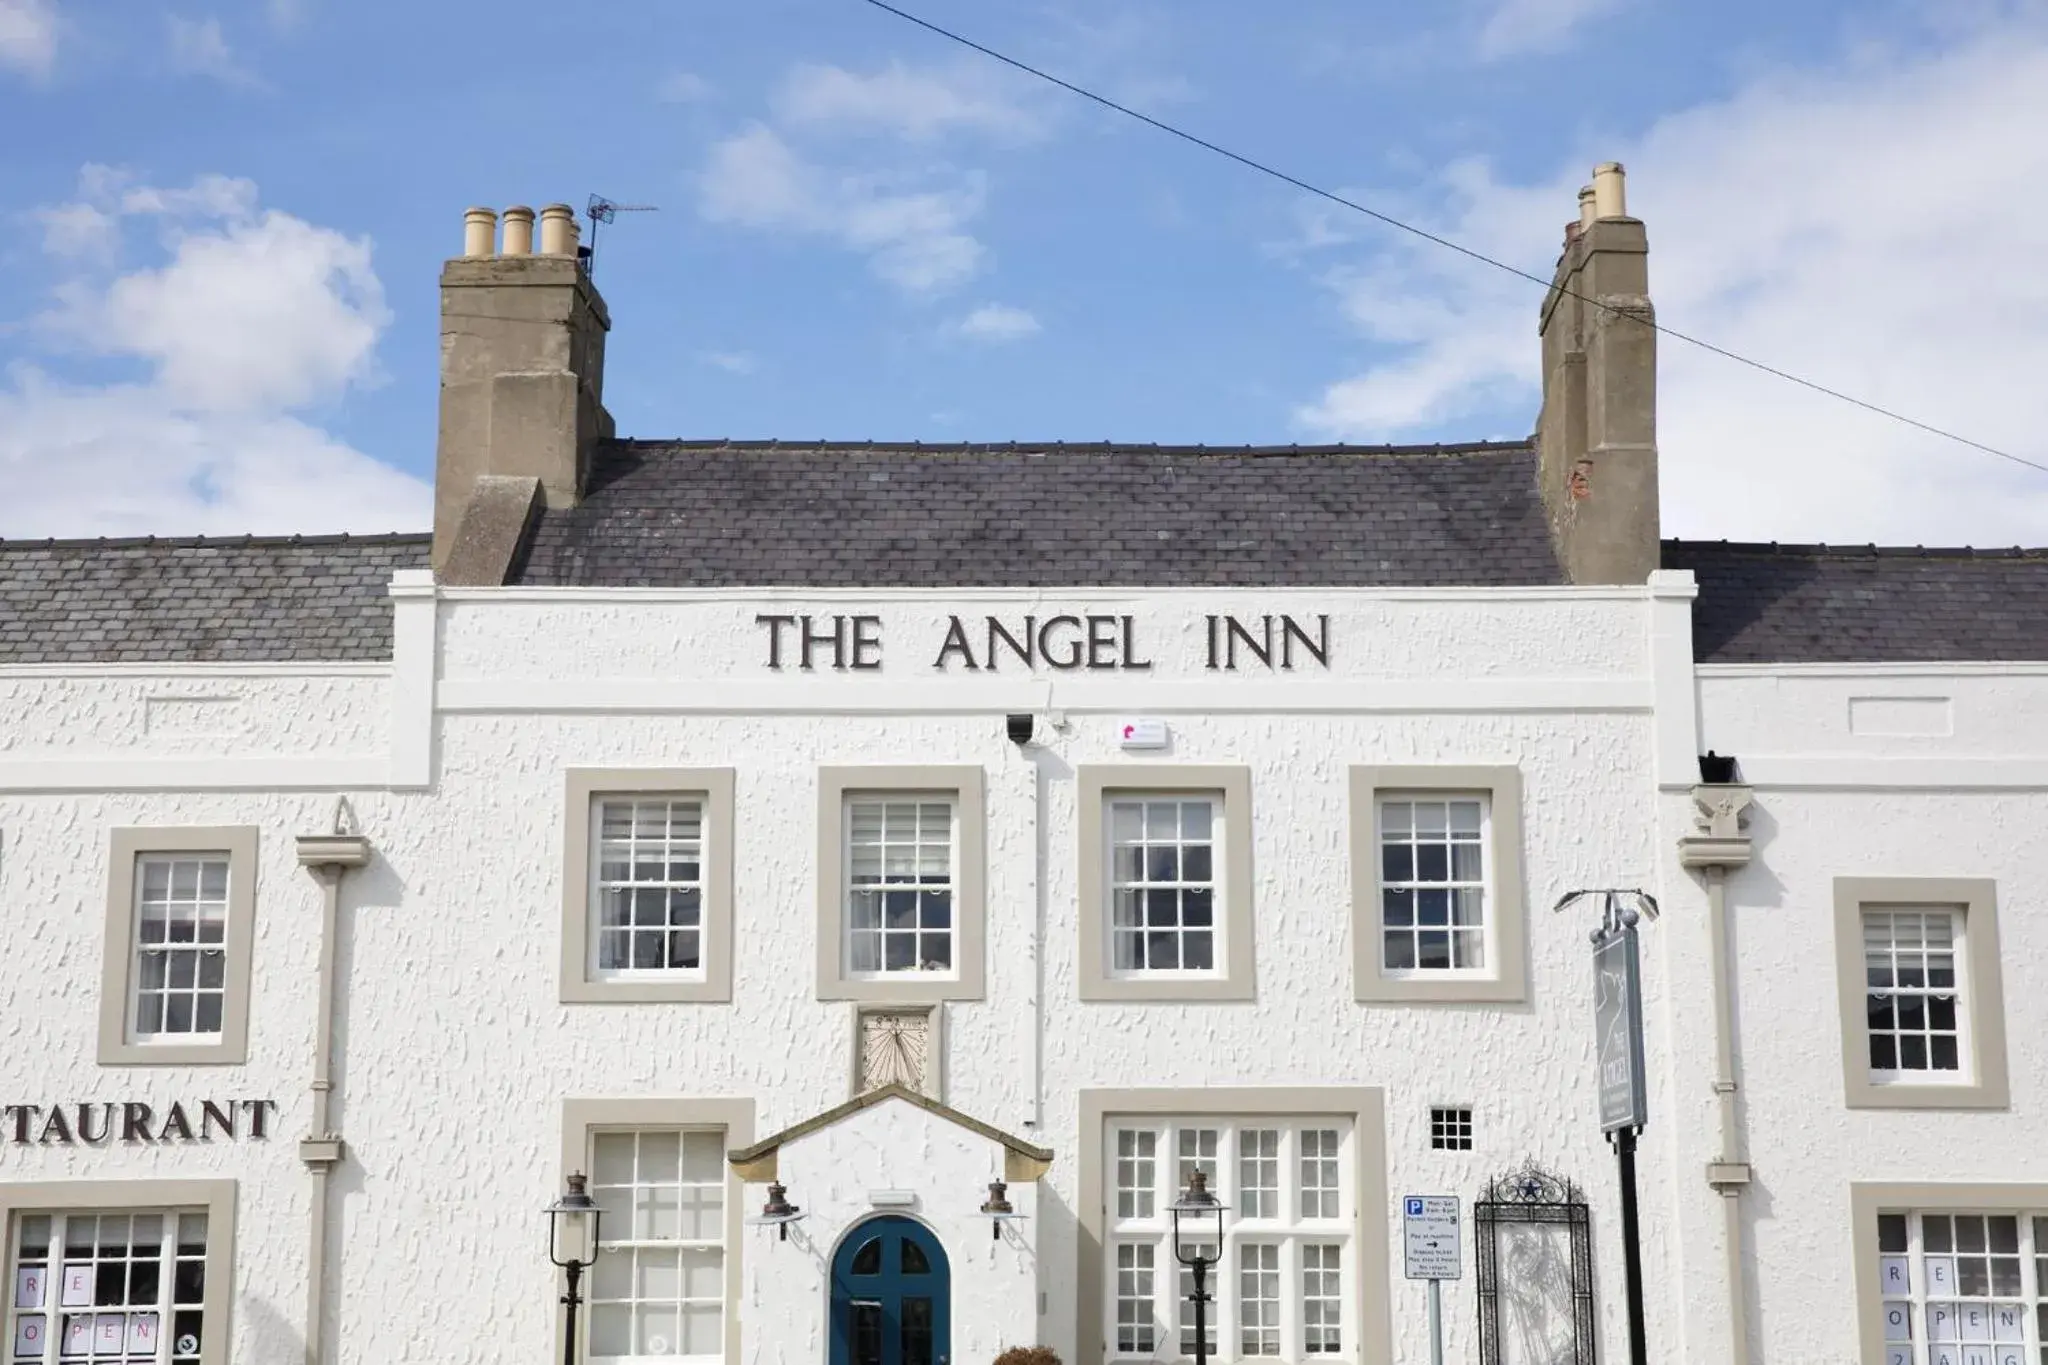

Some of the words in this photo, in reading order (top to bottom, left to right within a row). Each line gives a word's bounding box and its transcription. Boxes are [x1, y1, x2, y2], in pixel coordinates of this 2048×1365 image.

[755, 615, 881, 669] THE
[933, 615, 1152, 669] ANGEL
[1205, 615, 1330, 669] INN
[0, 1099, 275, 1144] TAURANT
